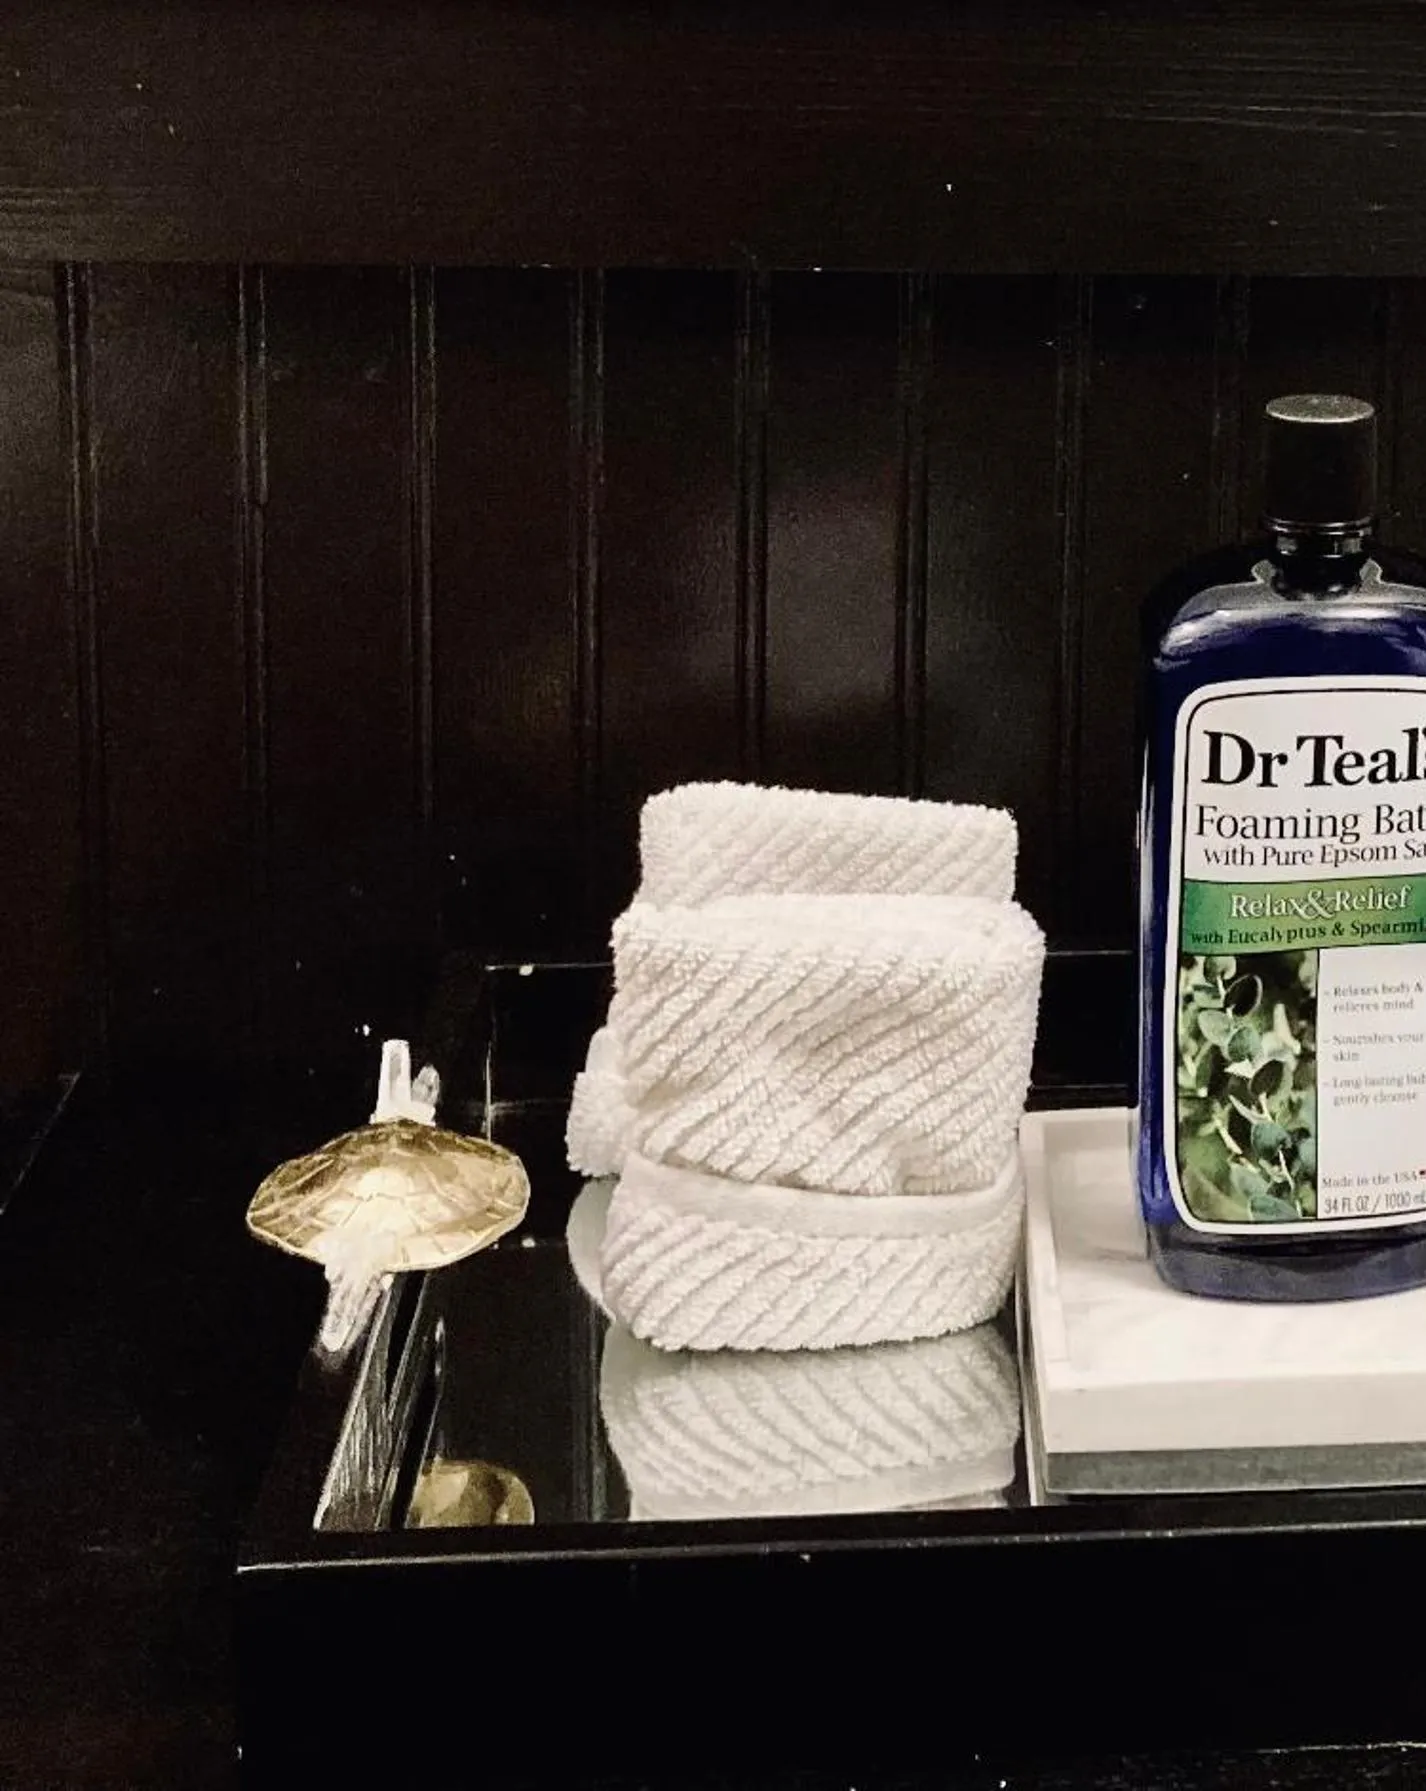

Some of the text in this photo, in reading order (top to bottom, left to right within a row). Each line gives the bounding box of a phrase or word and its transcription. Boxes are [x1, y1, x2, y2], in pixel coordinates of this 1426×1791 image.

[1200, 729, 1288, 788] Dr
[1194, 804, 1361, 845] Foaming
[1203, 844, 1256, 867] with
[1262, 845, 1315, 867] Pure
[1320, 843, 1398, 869] Epsom
[1191, 930, 1225, 945] with
[1227, 922, 1327, 945] Eucalyptus
[1332, 921, 1346, 937] &
